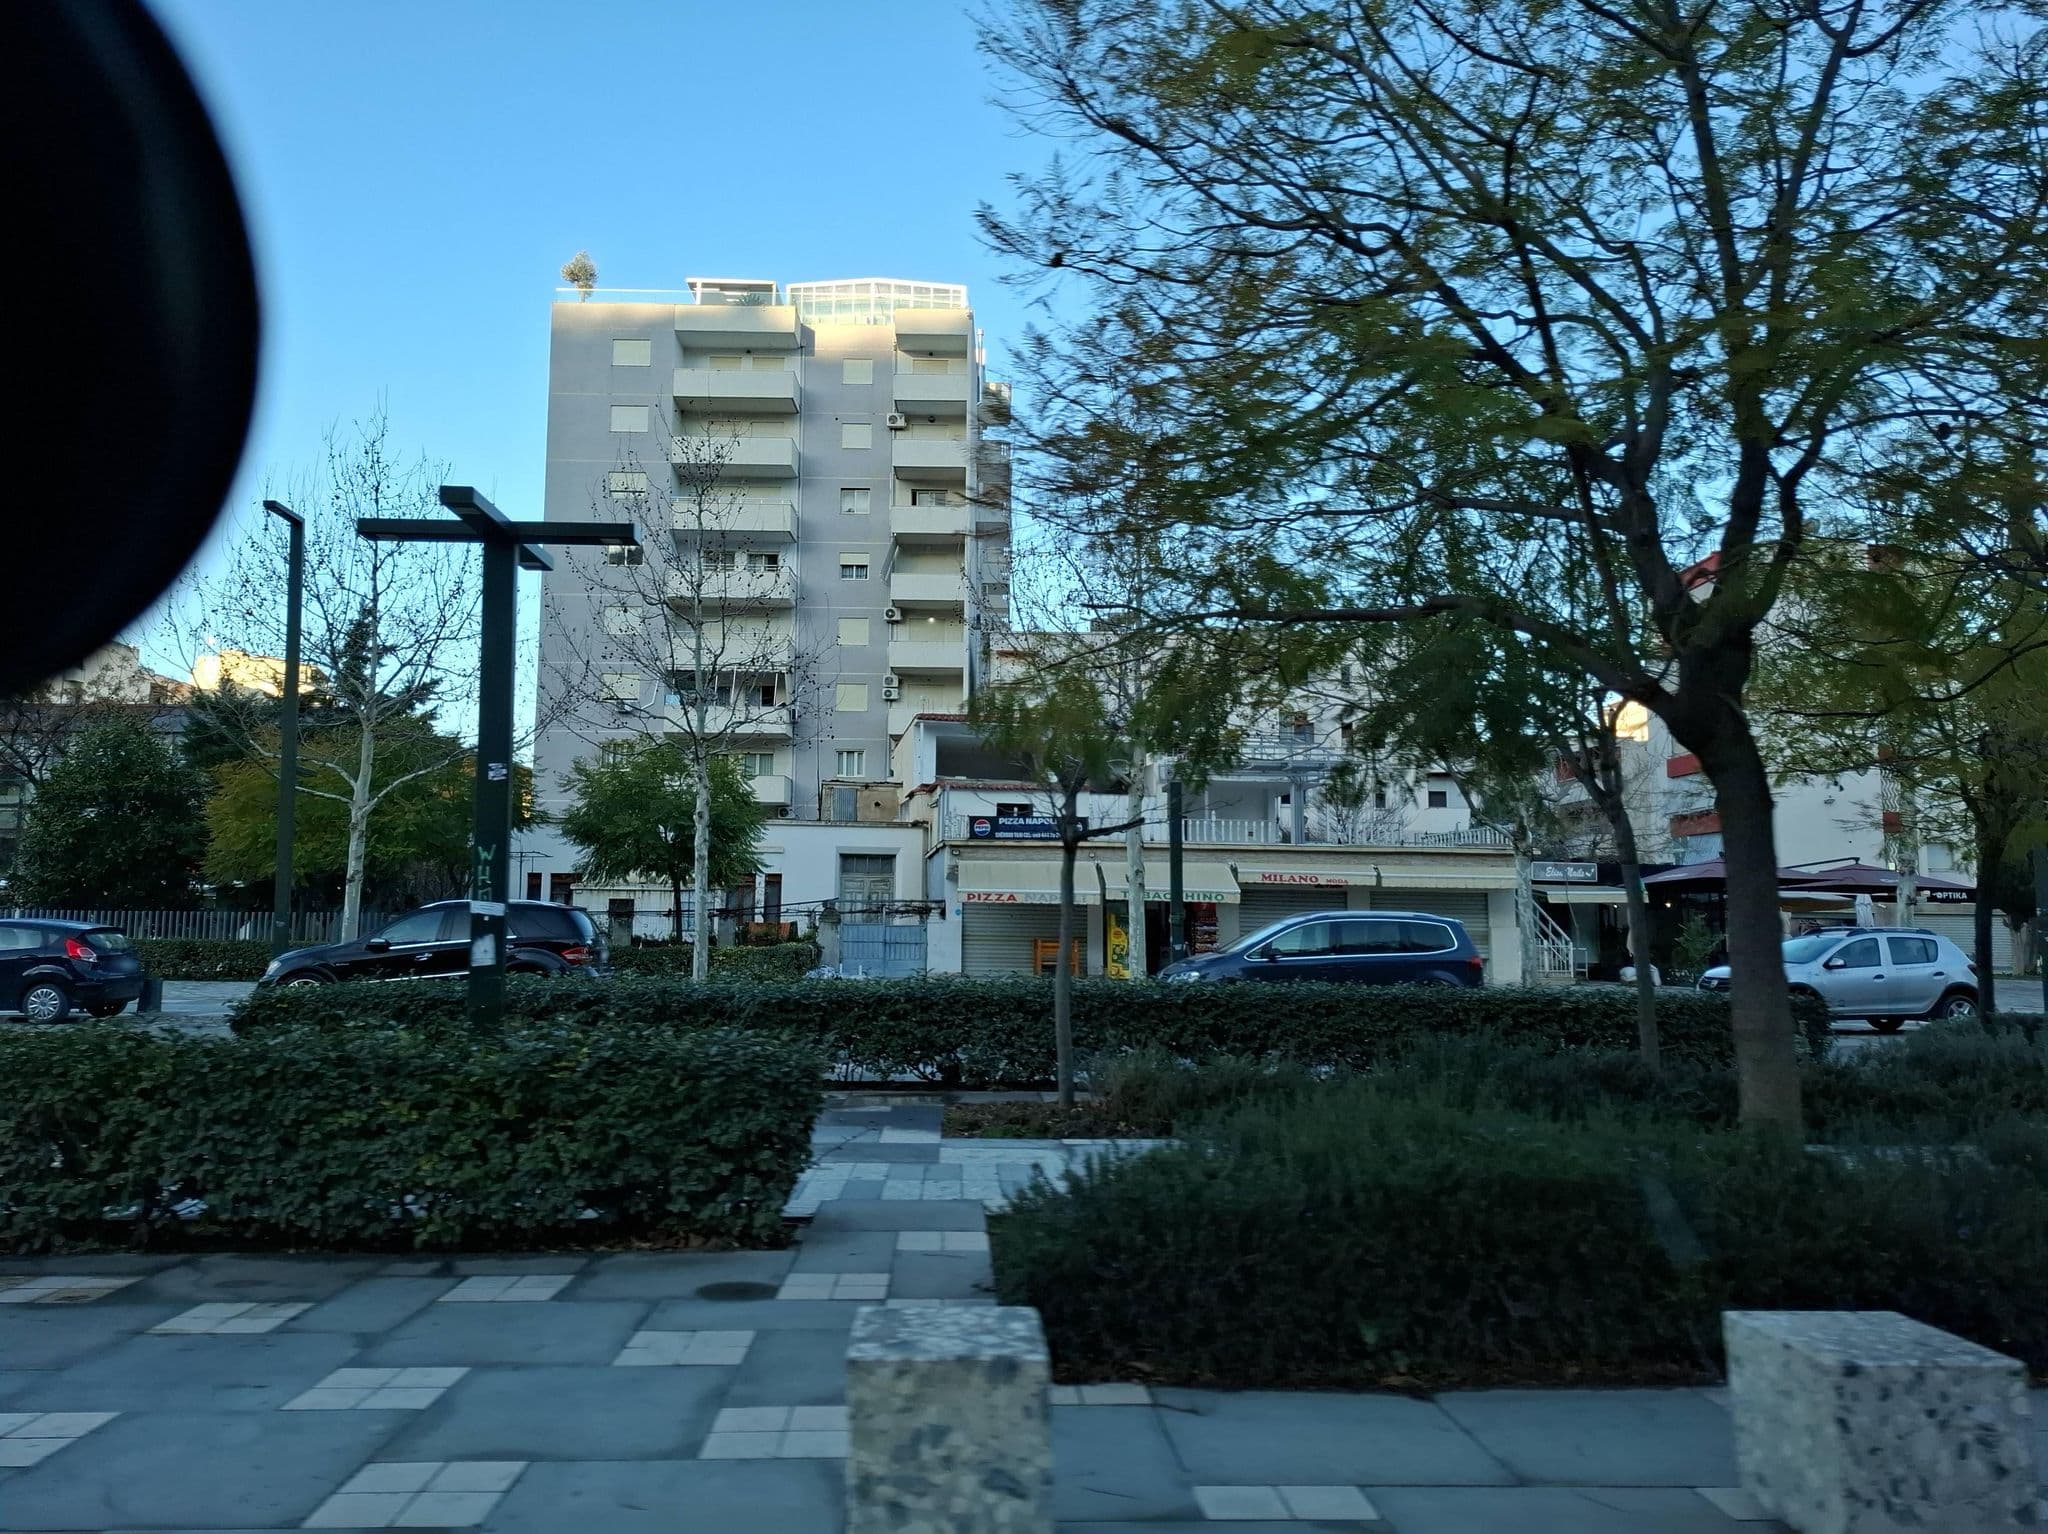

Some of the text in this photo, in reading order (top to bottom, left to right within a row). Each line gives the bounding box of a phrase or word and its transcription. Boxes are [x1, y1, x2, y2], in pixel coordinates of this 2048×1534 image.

[1261, 873, 1319, 883] MILANO
[966, 893, 1017, 902] PIZZA
[1121, 891, 1225, 901] TBACHINO
